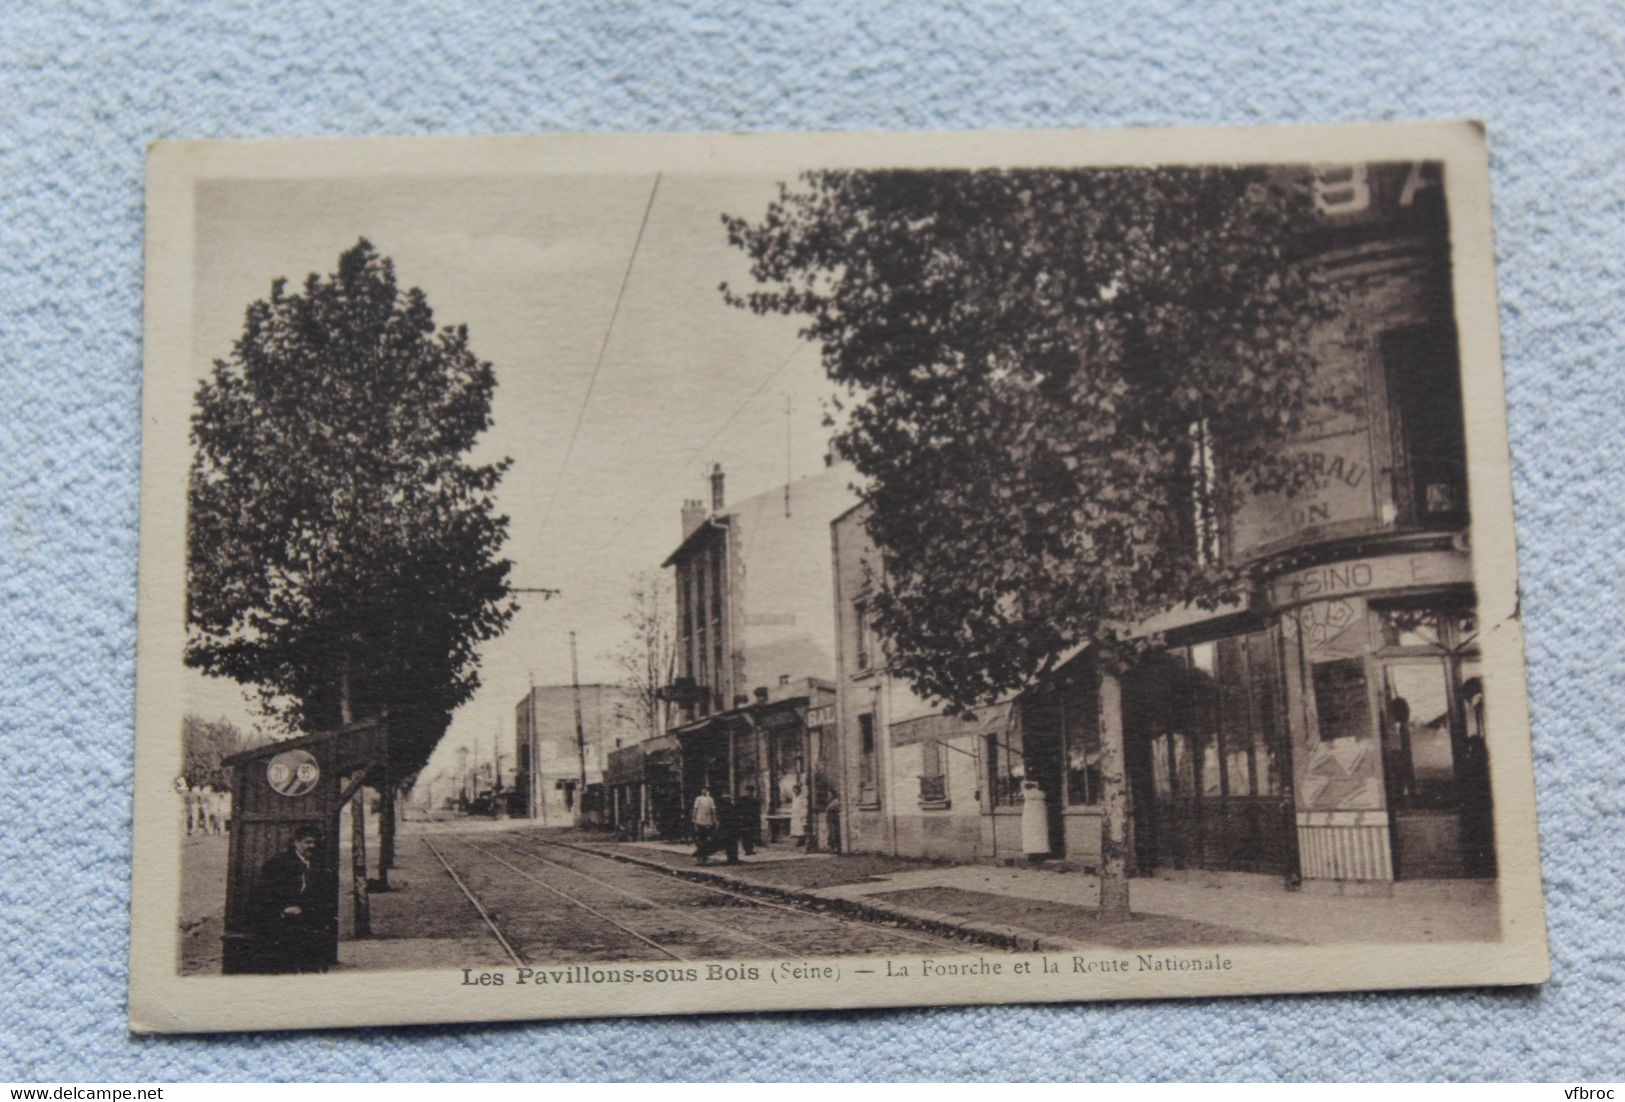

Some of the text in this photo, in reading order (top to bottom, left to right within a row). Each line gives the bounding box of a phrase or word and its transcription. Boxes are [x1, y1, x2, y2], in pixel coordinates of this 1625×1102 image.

[461, 968, 505, 987] Les
[515, 965, 698, 986] Pavillons-sous
[705, 963, 760, 983] Bois
[769, 961, 843, 985] (Seine)
[885, 959, 909, 978] La
[921, 958, 1003, 977] Fourche
[1013, 959, 1031, 975] et
[1041, 955, 1060, 975] la
[1071, 955, 1130, 975] Route
[1136, 953, 1233, 973] Nationale
